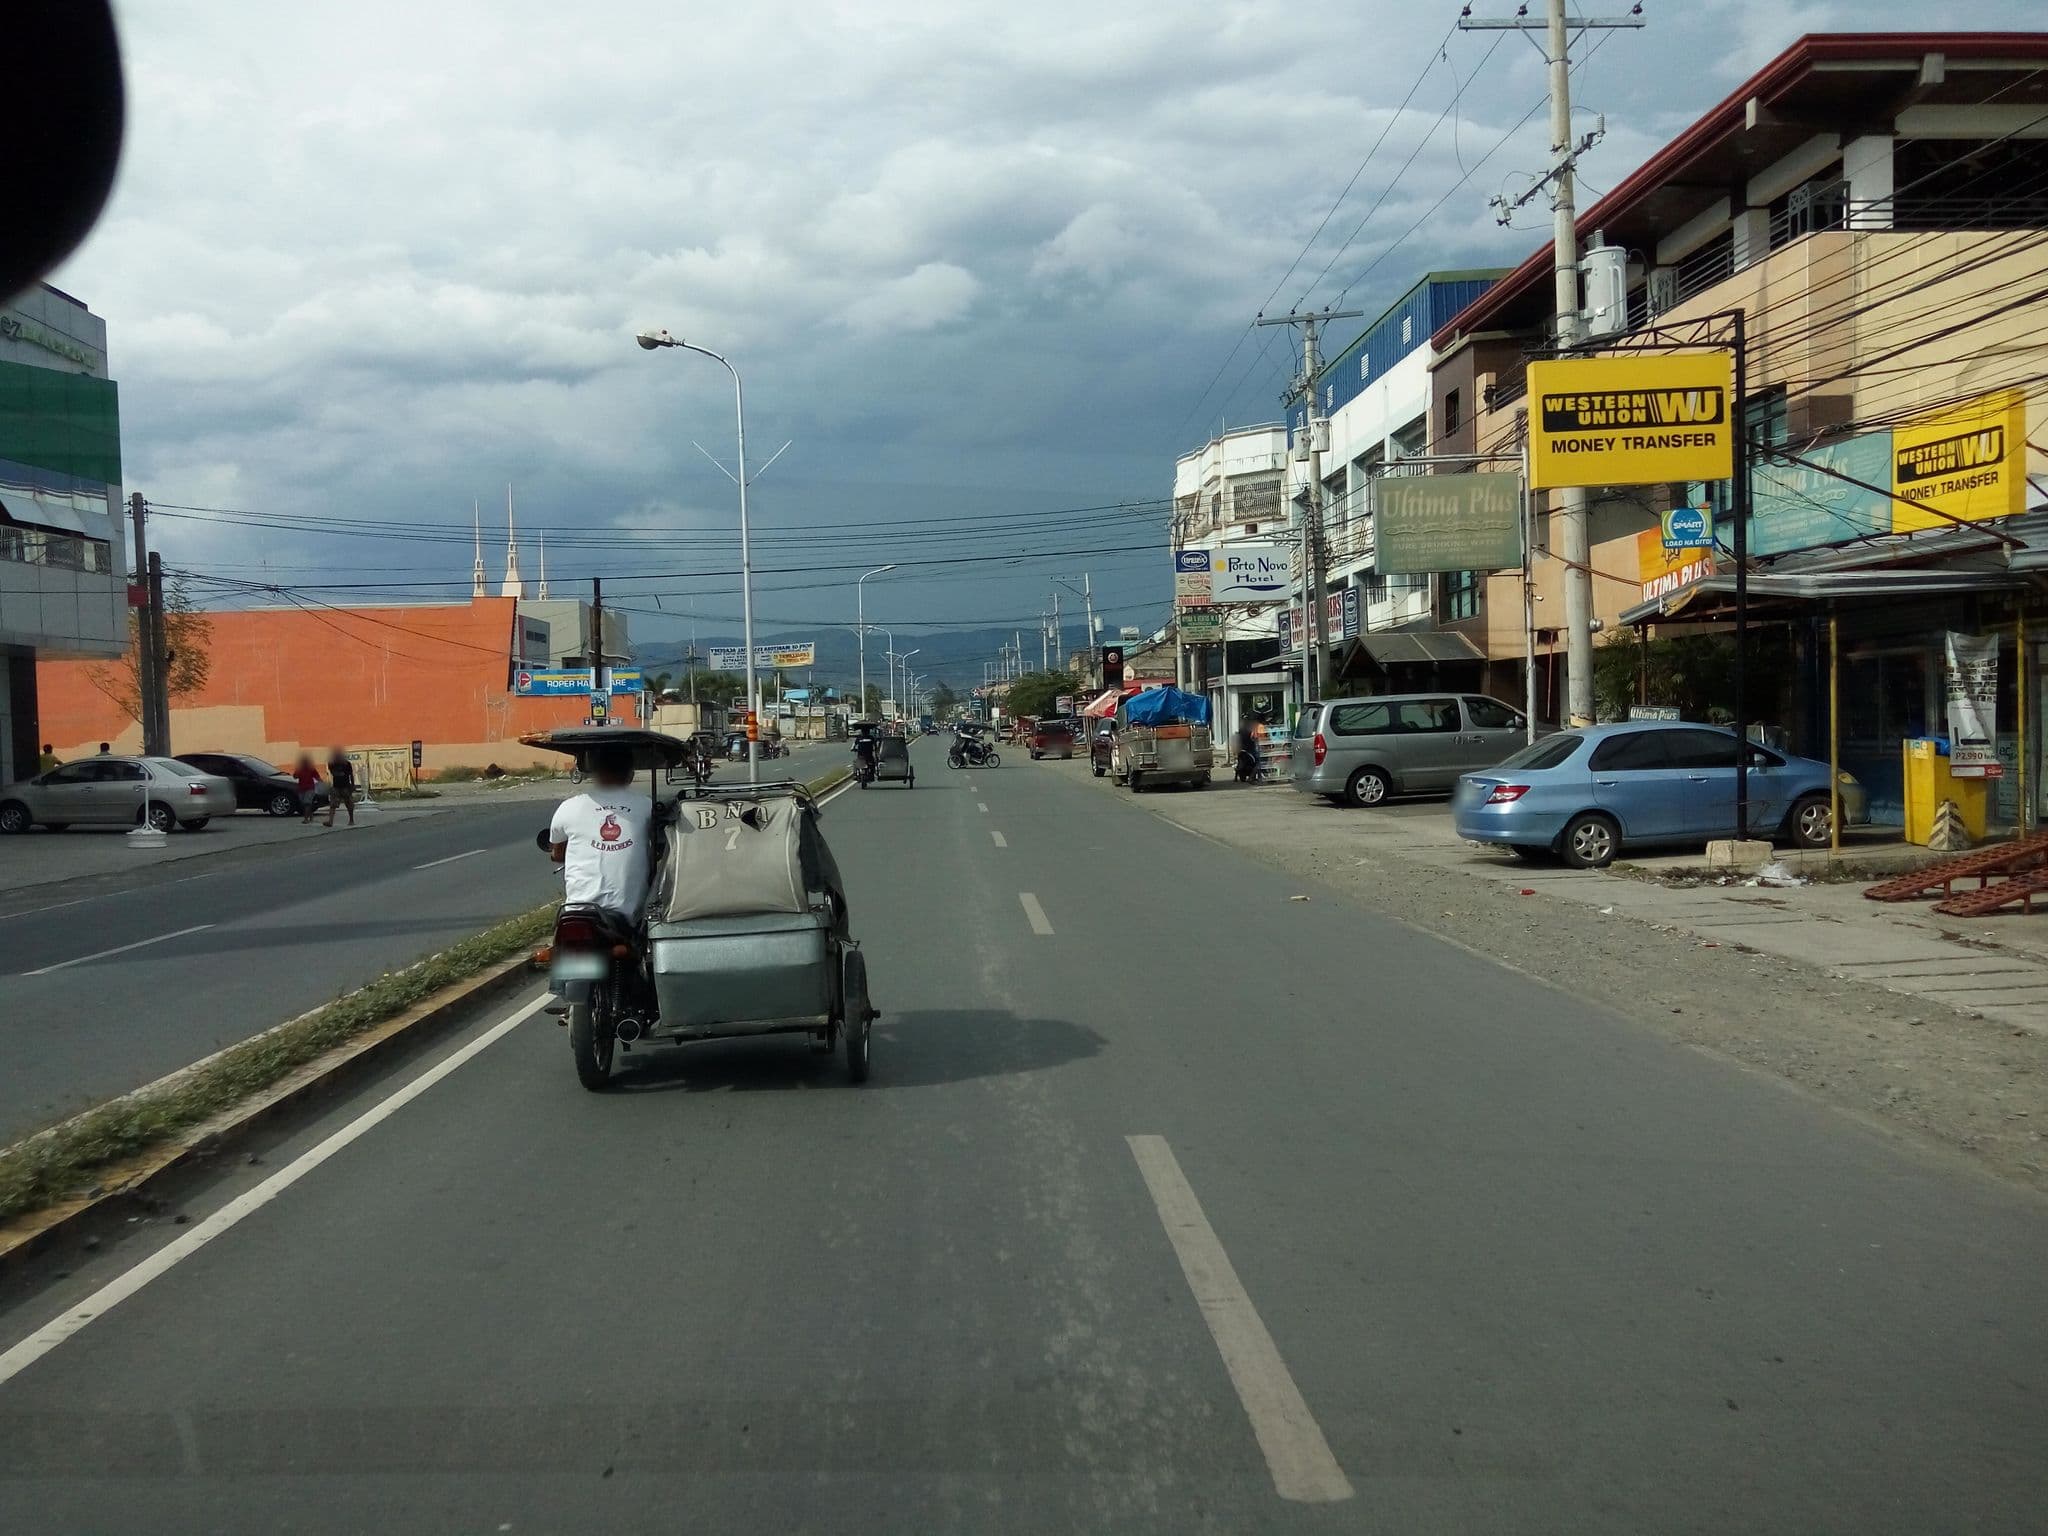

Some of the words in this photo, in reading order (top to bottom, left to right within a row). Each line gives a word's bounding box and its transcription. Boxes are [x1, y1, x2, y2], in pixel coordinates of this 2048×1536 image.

[1545, 393, 1647, 412] WESTERN
[1656, 390, 1718, 424] WU
[1578, 409, 1647, 426] UNION
[1552, 437, 1617, 454] MONEY
[1622, 433, 1717, 451] TRANSFER
[1898, 440, 1957, 466] WESTERN
[1960, 429, 2001, 467] WU
[1915, 455, 1956, 476] UNION
[1900, 484, 1938, 501] MONEY
[1940, 471, 1999, 495] TRANSFER
[1382, 485, 1460, 519] Ultima
[1467, 481, 1513, 514] Plus
[1672, 520, 1703, 530] SMART
[1665, 539, 1683, 547] LOAD
[1228, 556, 1256, 573] Porto
[1258, 556, 1288, 573] Novo
[1236, 574, 1274, 583] Hotel
[1643, 571, 1679, 602] ULTIMA
[547, 680, 575, 688] ROPER
[723, 826, 742, 851] 7
